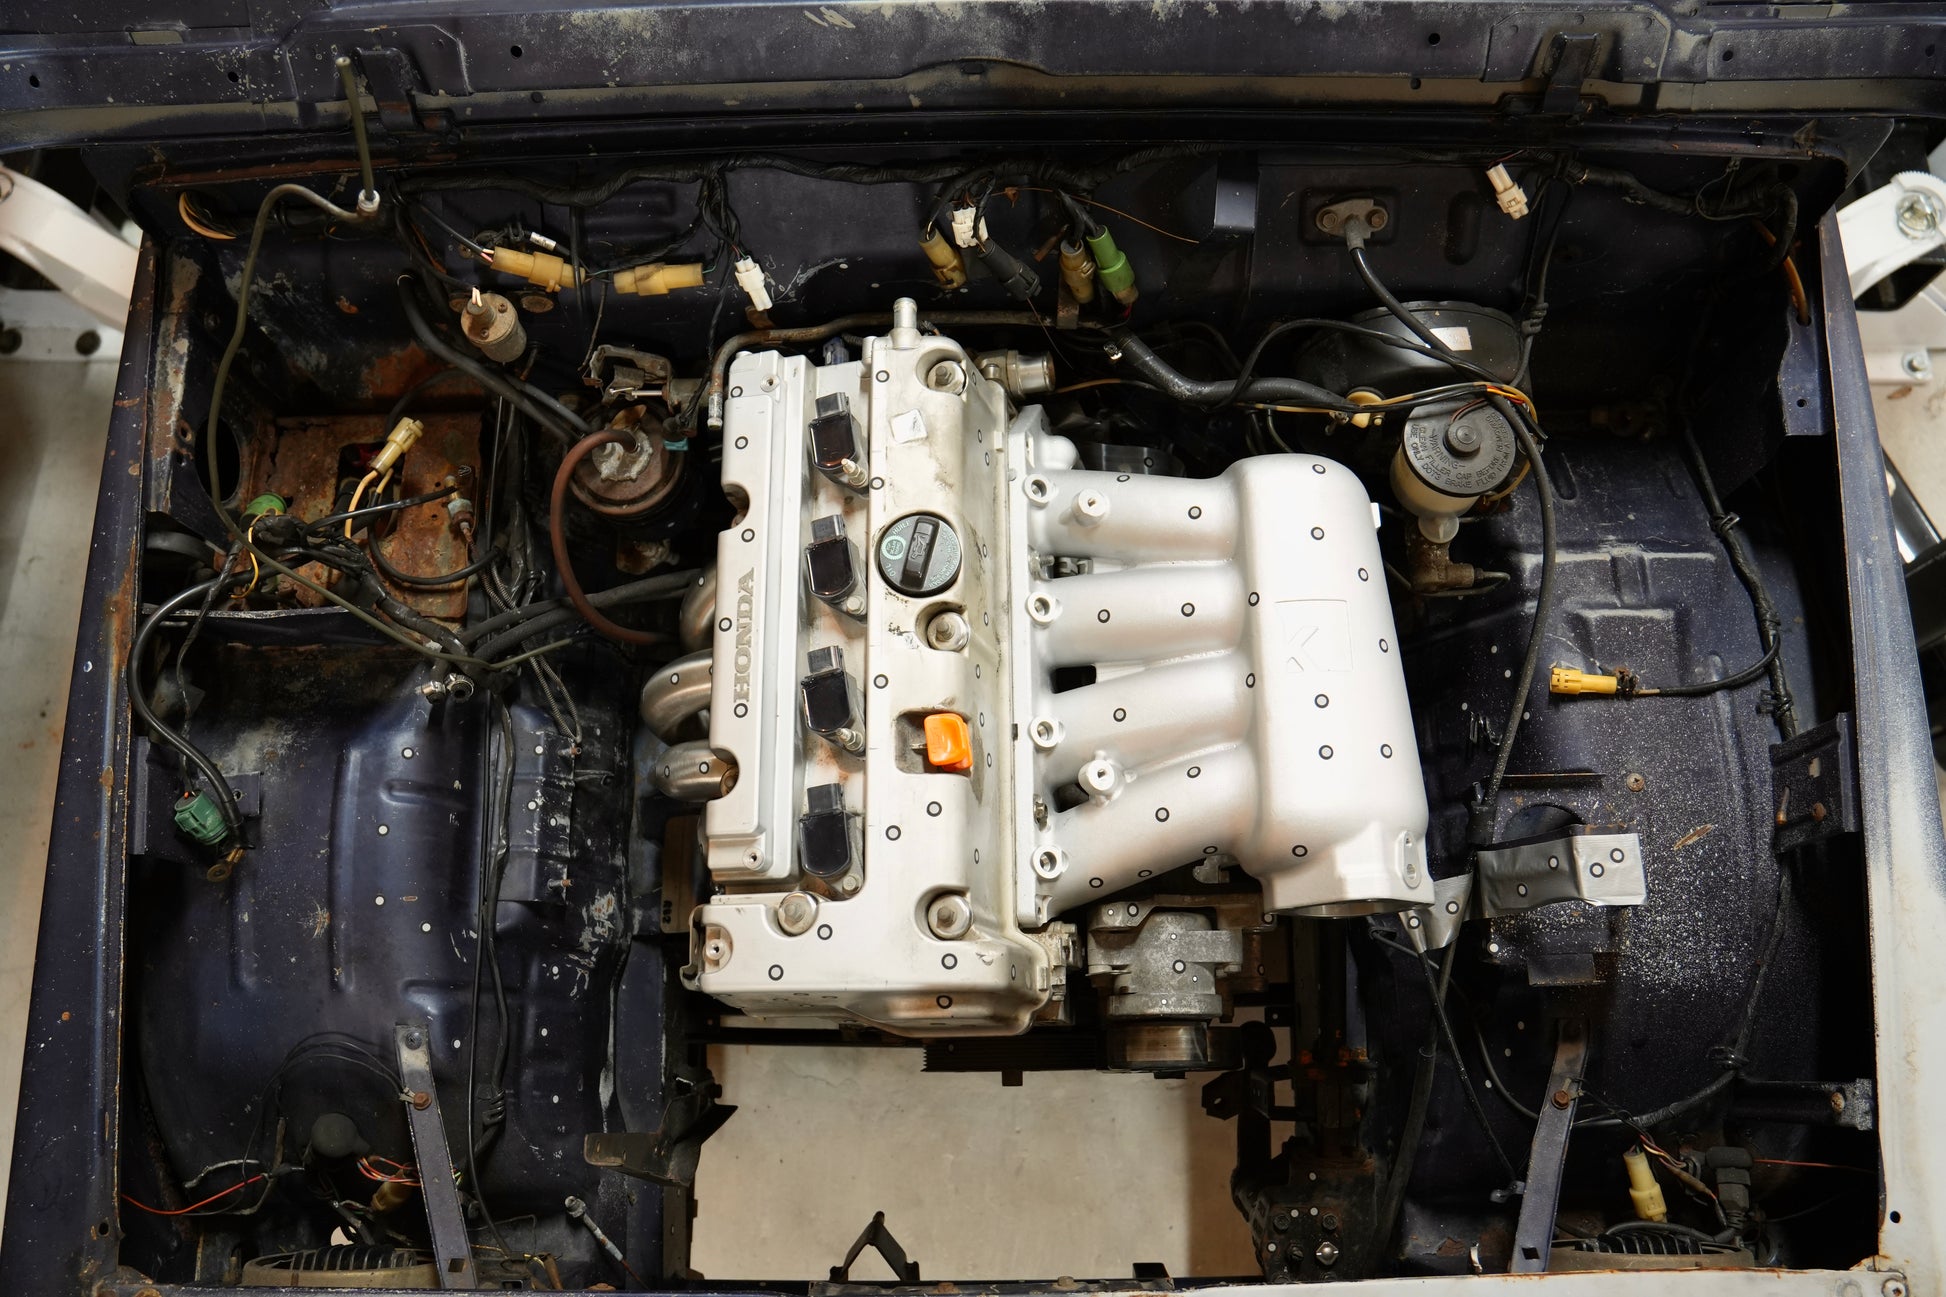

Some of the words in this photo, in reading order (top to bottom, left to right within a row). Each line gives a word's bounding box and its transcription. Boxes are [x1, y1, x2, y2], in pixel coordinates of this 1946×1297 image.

[1410, 423, 1419, 438] USE
[1410, 442, 1425, 461] ONLY
[1418, 426, 1429, 452] CLEAN
[1425, 455, 1451, 477] FILLER
[1456, 472, 1473, 480] CAP
[1476, 456, 1500, 478] BEFORE
[1421, 463, 1441, 480] DOT3
[1475, 472, 1497, 487] FLUID
[1444, 479, 1473, 488] BRAKE
[885, 563, 896, 577] OIL
[733, 566, 755, 704] HONDA
